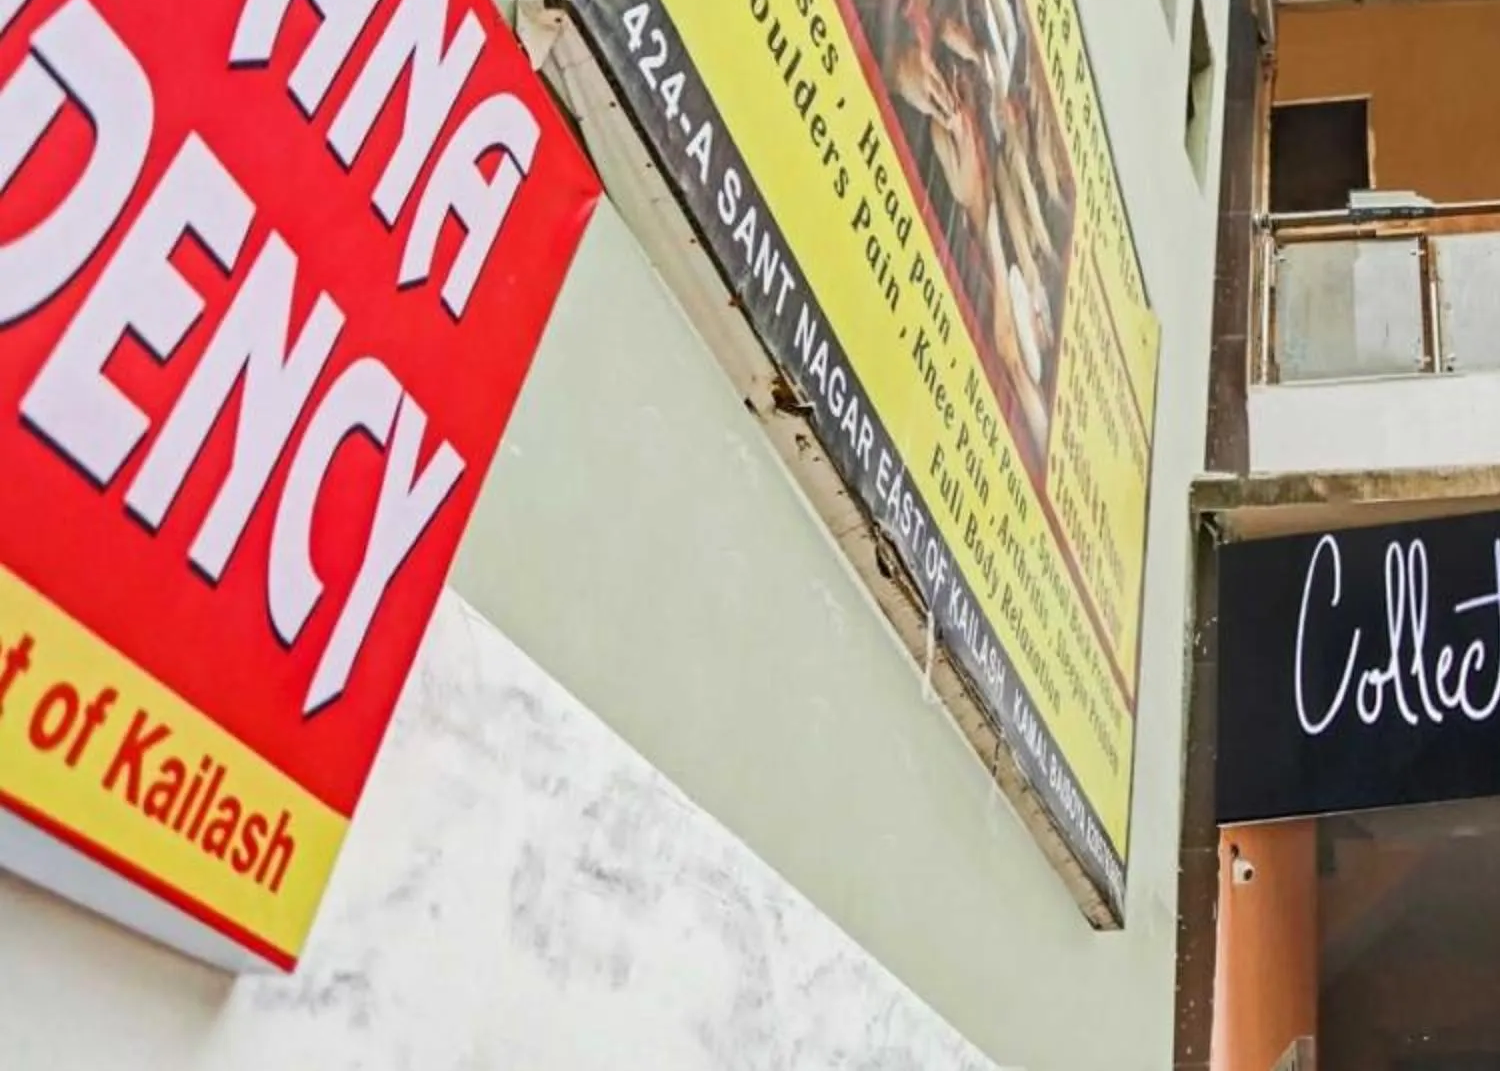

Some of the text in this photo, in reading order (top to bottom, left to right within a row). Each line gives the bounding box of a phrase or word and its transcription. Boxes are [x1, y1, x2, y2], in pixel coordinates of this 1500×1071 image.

[623, 4, 712, 184] 424-A
[718, 168, 795, 313] SANT
[794, 303, 874, 462] NAGAR
[876, 449, 924, 552] EAST
[926, 538, 947, 597] OF
[858, 121, 912, 249] Head
[964, 368, 998, 455] Neck
[999, 447, 1027, 522] Pain
[912, 327, 954, 428] Knee
[930, 443, 963, 523] Full
[964, 510, 998, 599] Body
[29, 681, 119, 767] of
[102, 707, 295, 895] Kailash
